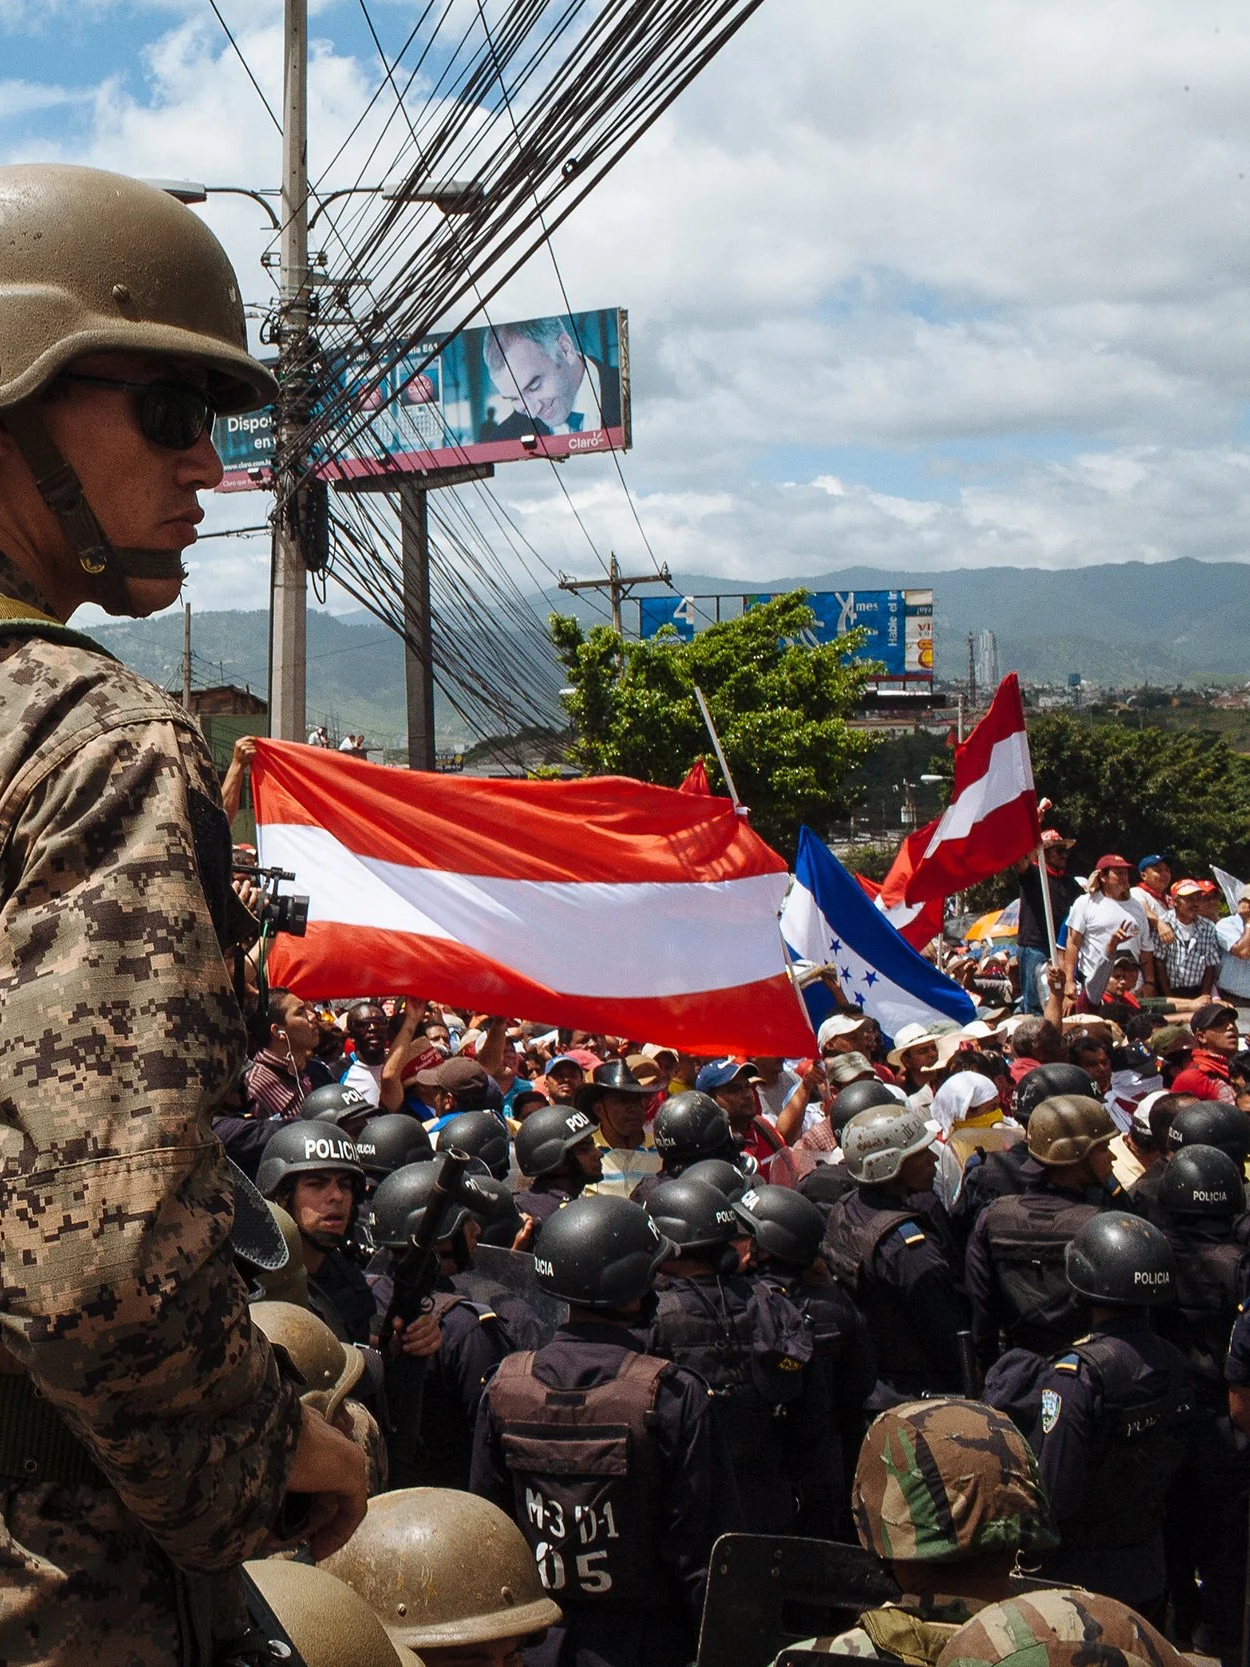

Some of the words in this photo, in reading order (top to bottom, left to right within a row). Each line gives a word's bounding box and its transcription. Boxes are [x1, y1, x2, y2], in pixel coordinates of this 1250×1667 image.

[227, 416, 273, 434] Dispo
[568, 436, 600, 450] Claro
[304, 1138, 361, 1164] POLICIA
[1192, 1189, 1228, 1202] POLICIA
[1133, 1270, 1171, 1285] POLICIA
[535, 1541, 614, 1593] 05
